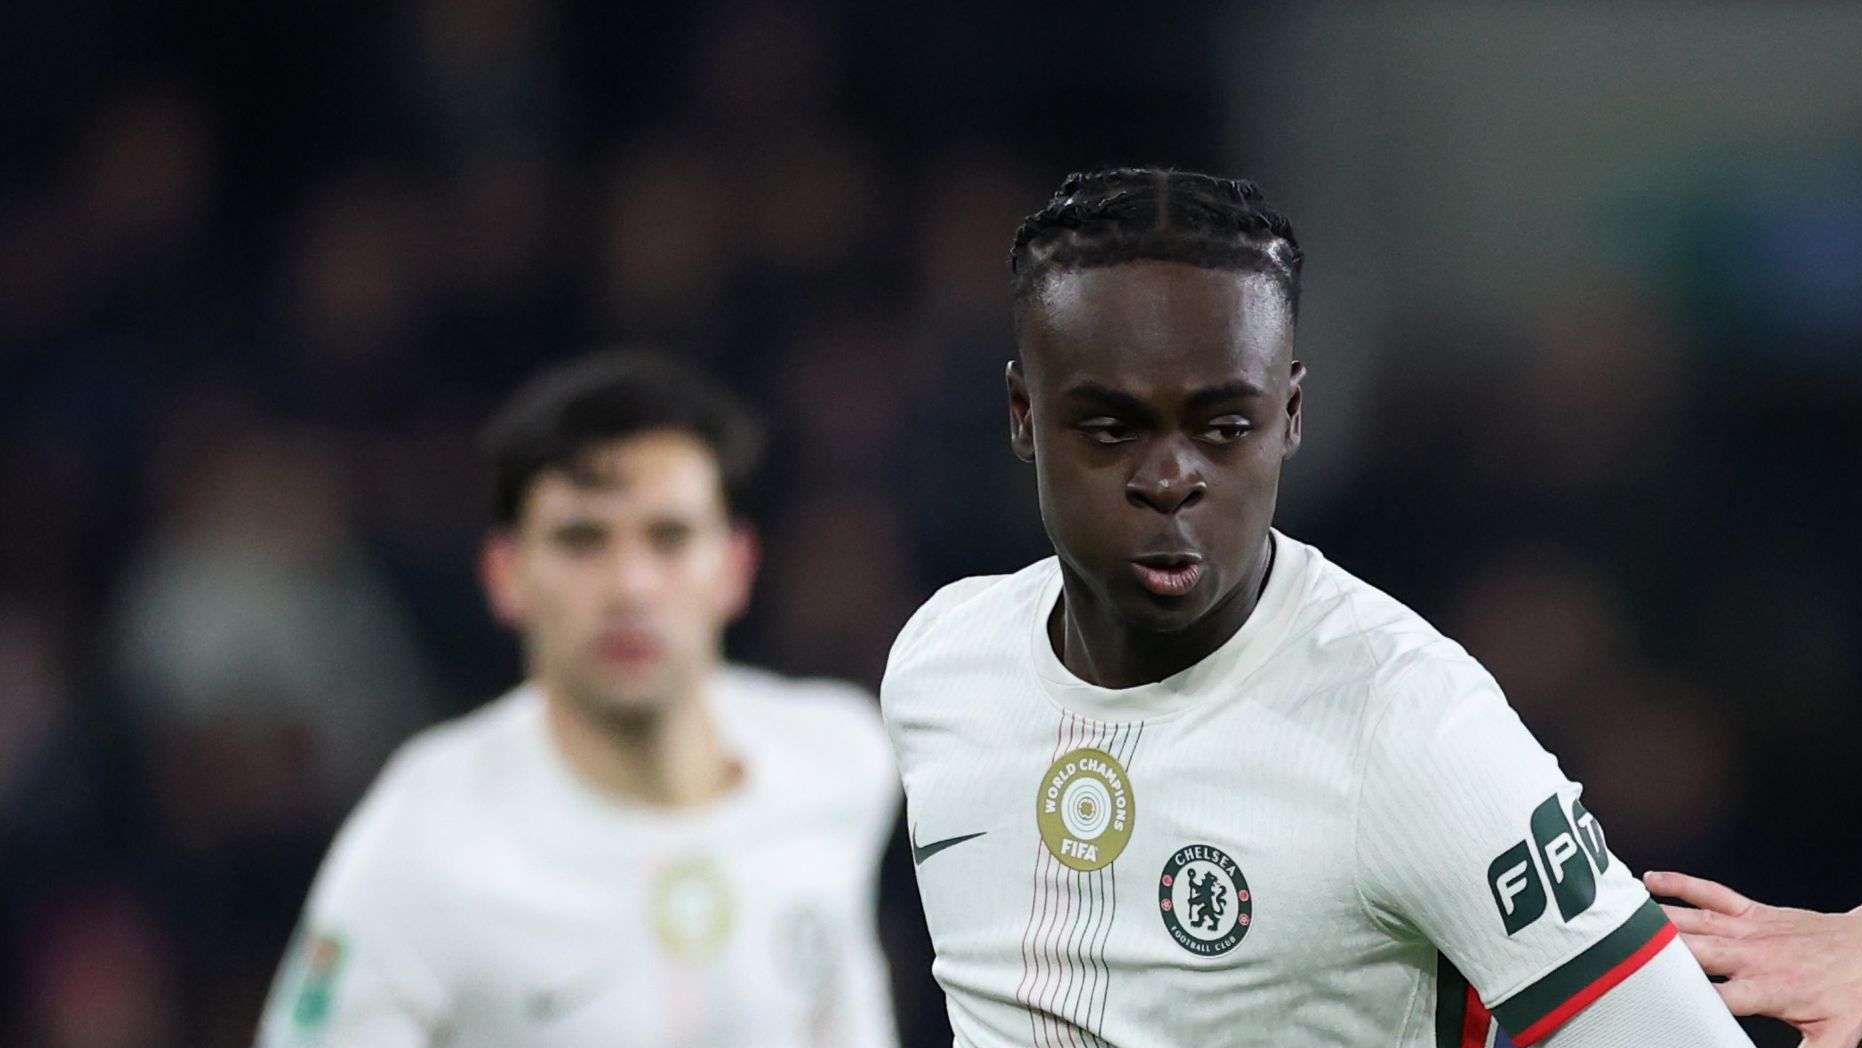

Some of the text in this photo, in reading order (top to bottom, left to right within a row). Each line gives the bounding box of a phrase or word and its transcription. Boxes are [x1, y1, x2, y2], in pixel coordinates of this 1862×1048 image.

[1044, 757, 1127, 832] WORLD CHAMPIONS
[1060, 838, 1099, 863] FIFA
[1174, 846, 1236, 878] CHELSEA
[1496, 811, 1601, 917] FPT
[1169, 924, 1237, 954] FOOTBALL CLUB
